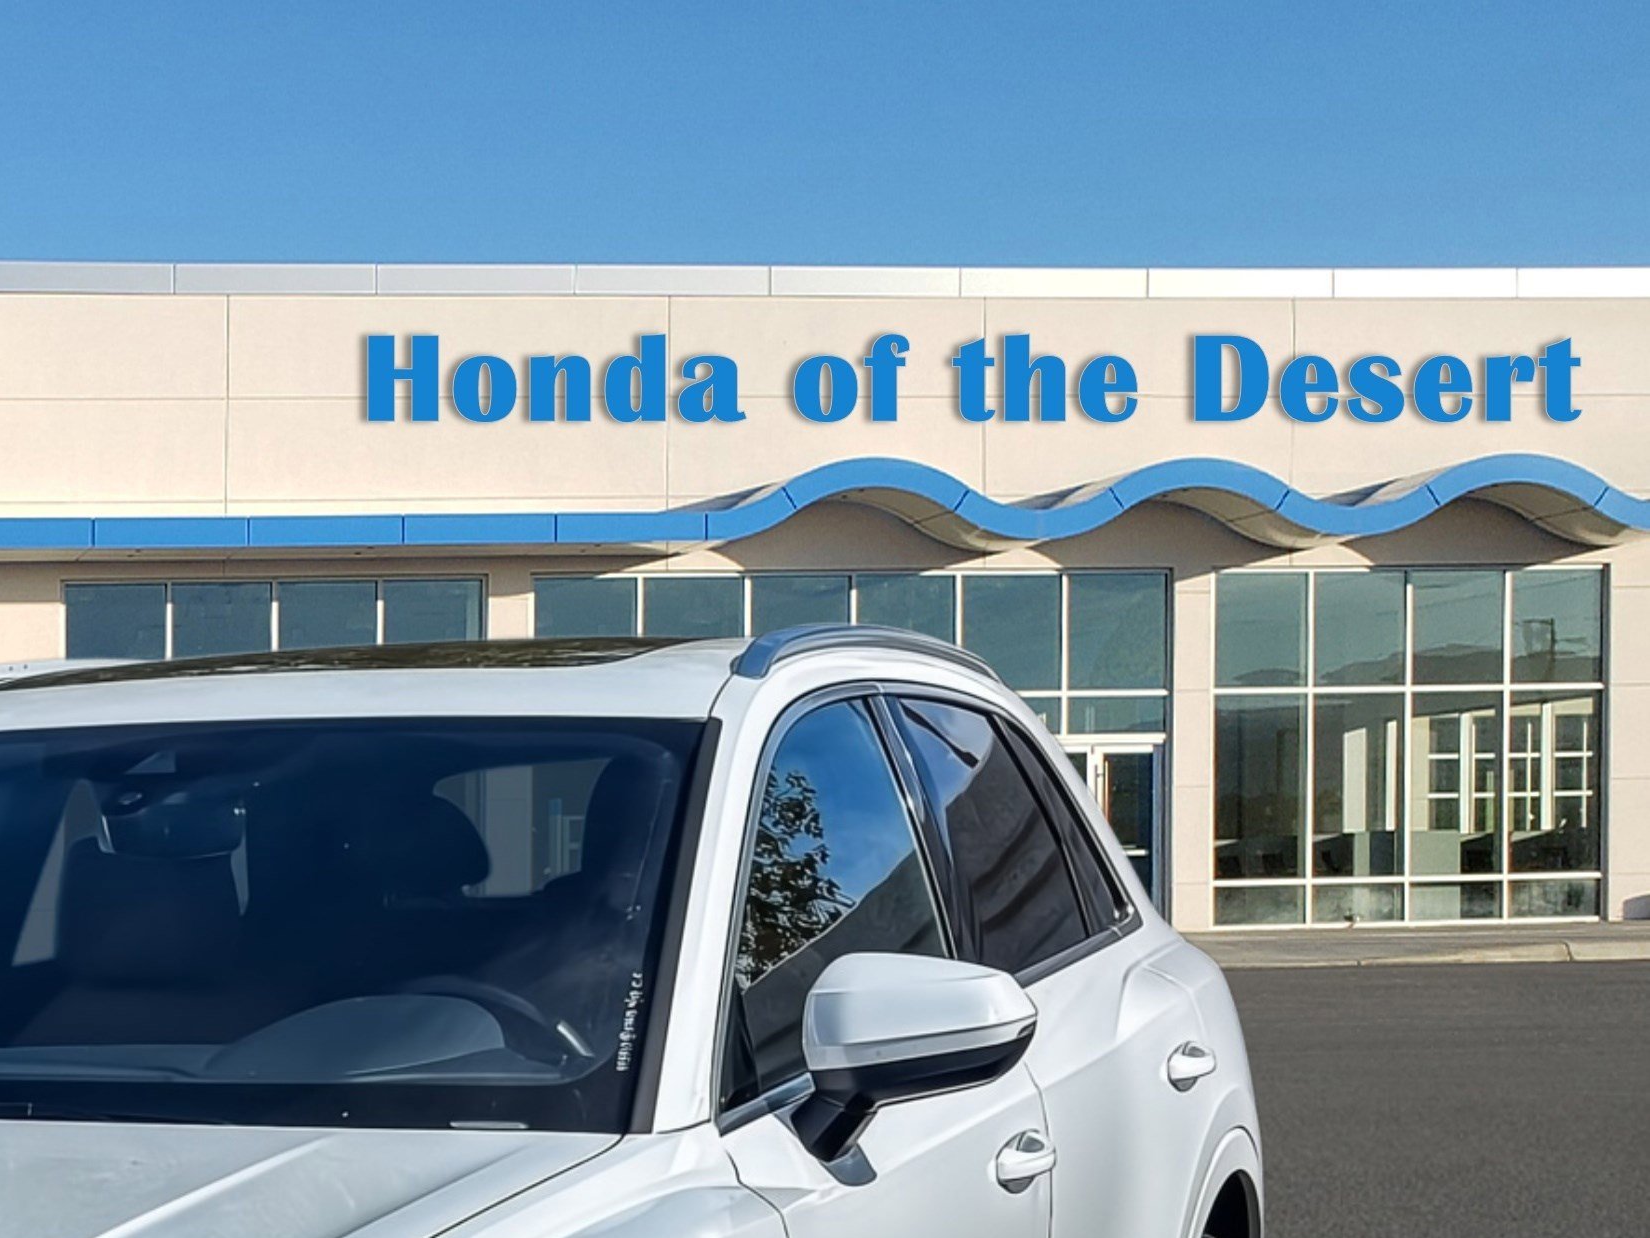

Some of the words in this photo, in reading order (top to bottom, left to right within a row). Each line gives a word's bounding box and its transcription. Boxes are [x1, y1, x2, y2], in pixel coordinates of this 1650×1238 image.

[366, 334, 747, 423] Honda
[794, 333, 910, 423] of
[952, 333, 1139, 423] the
[1194, 334, 1583, 423] Desert
